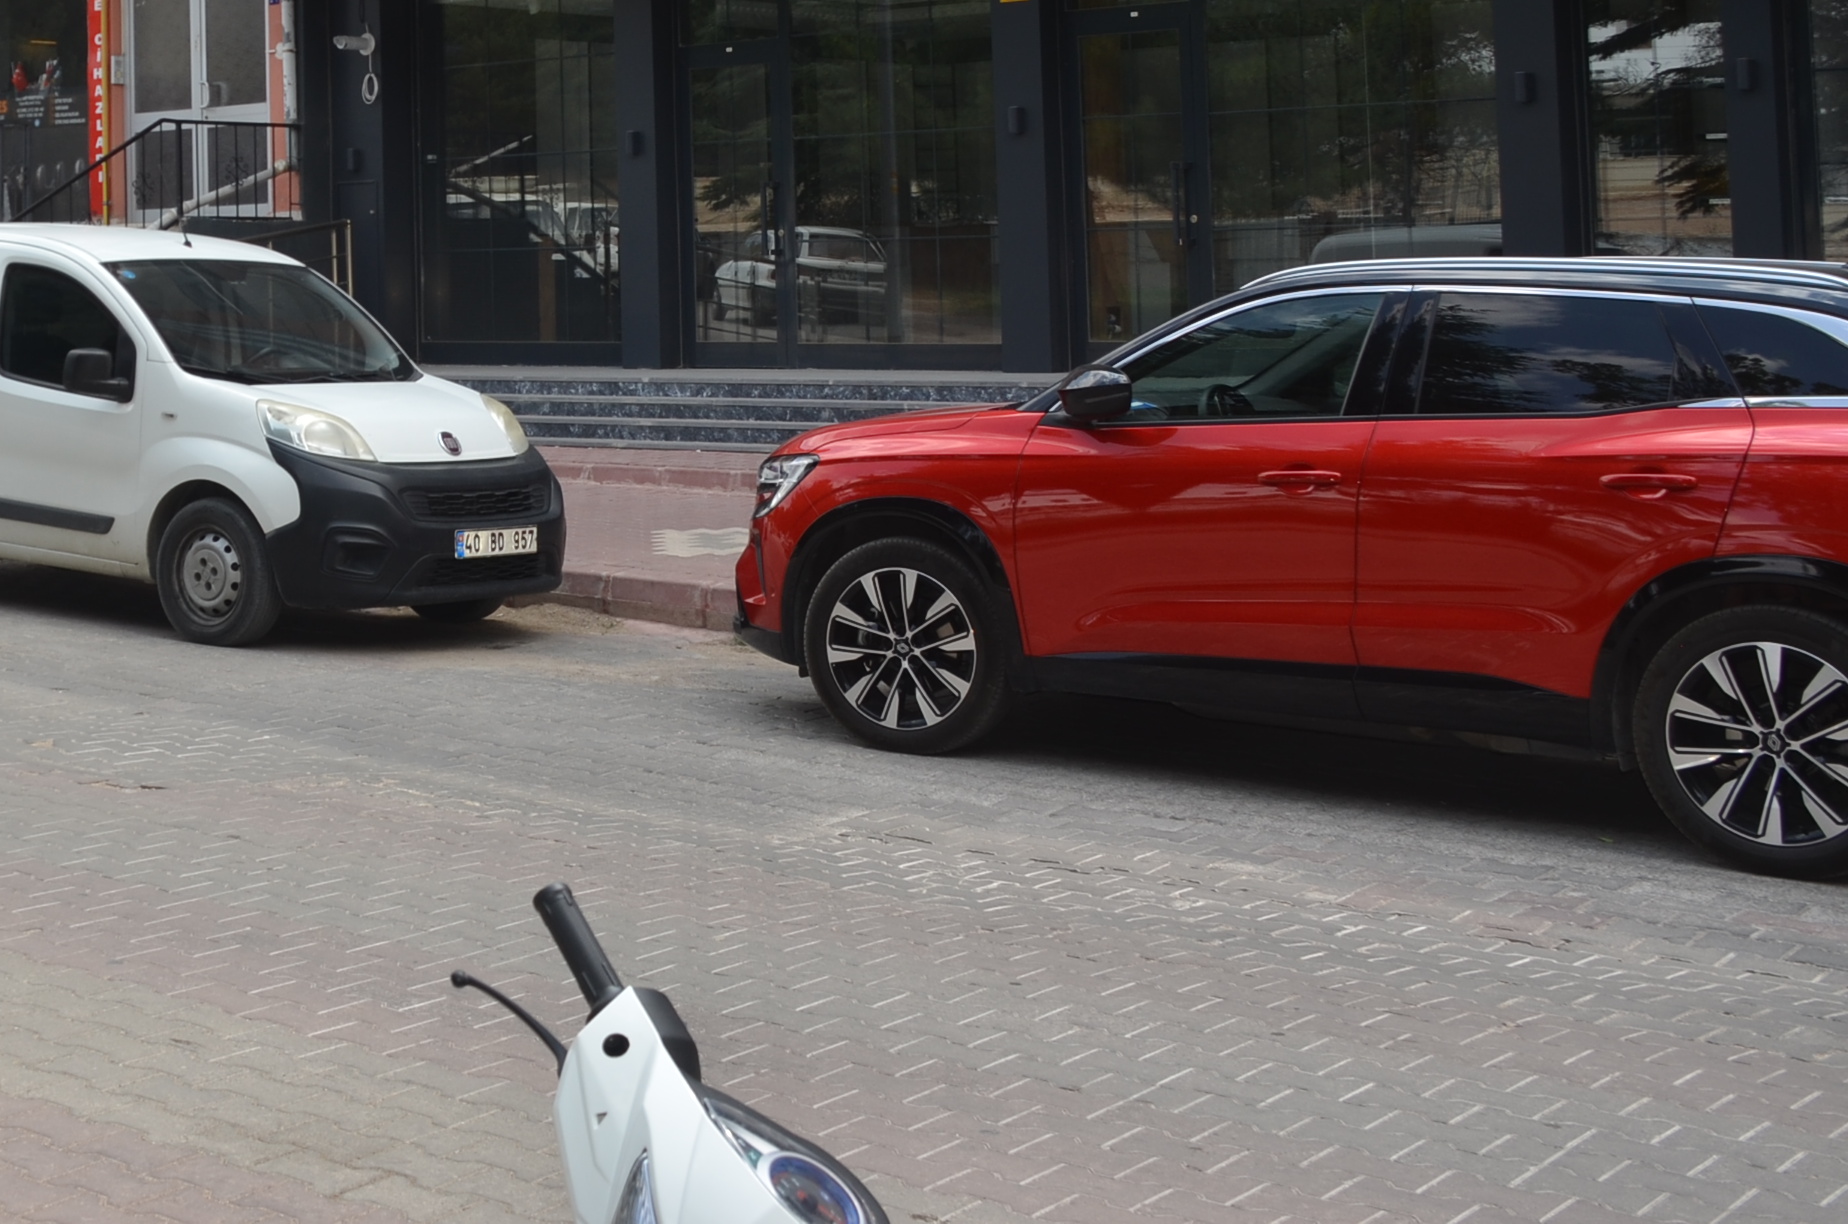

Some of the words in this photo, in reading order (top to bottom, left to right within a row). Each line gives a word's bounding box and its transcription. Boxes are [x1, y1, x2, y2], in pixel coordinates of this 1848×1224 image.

[465, 532, 480, 554] 40
[490, 532, 505, 552] BD
[513, 529, 534, 550] 957
